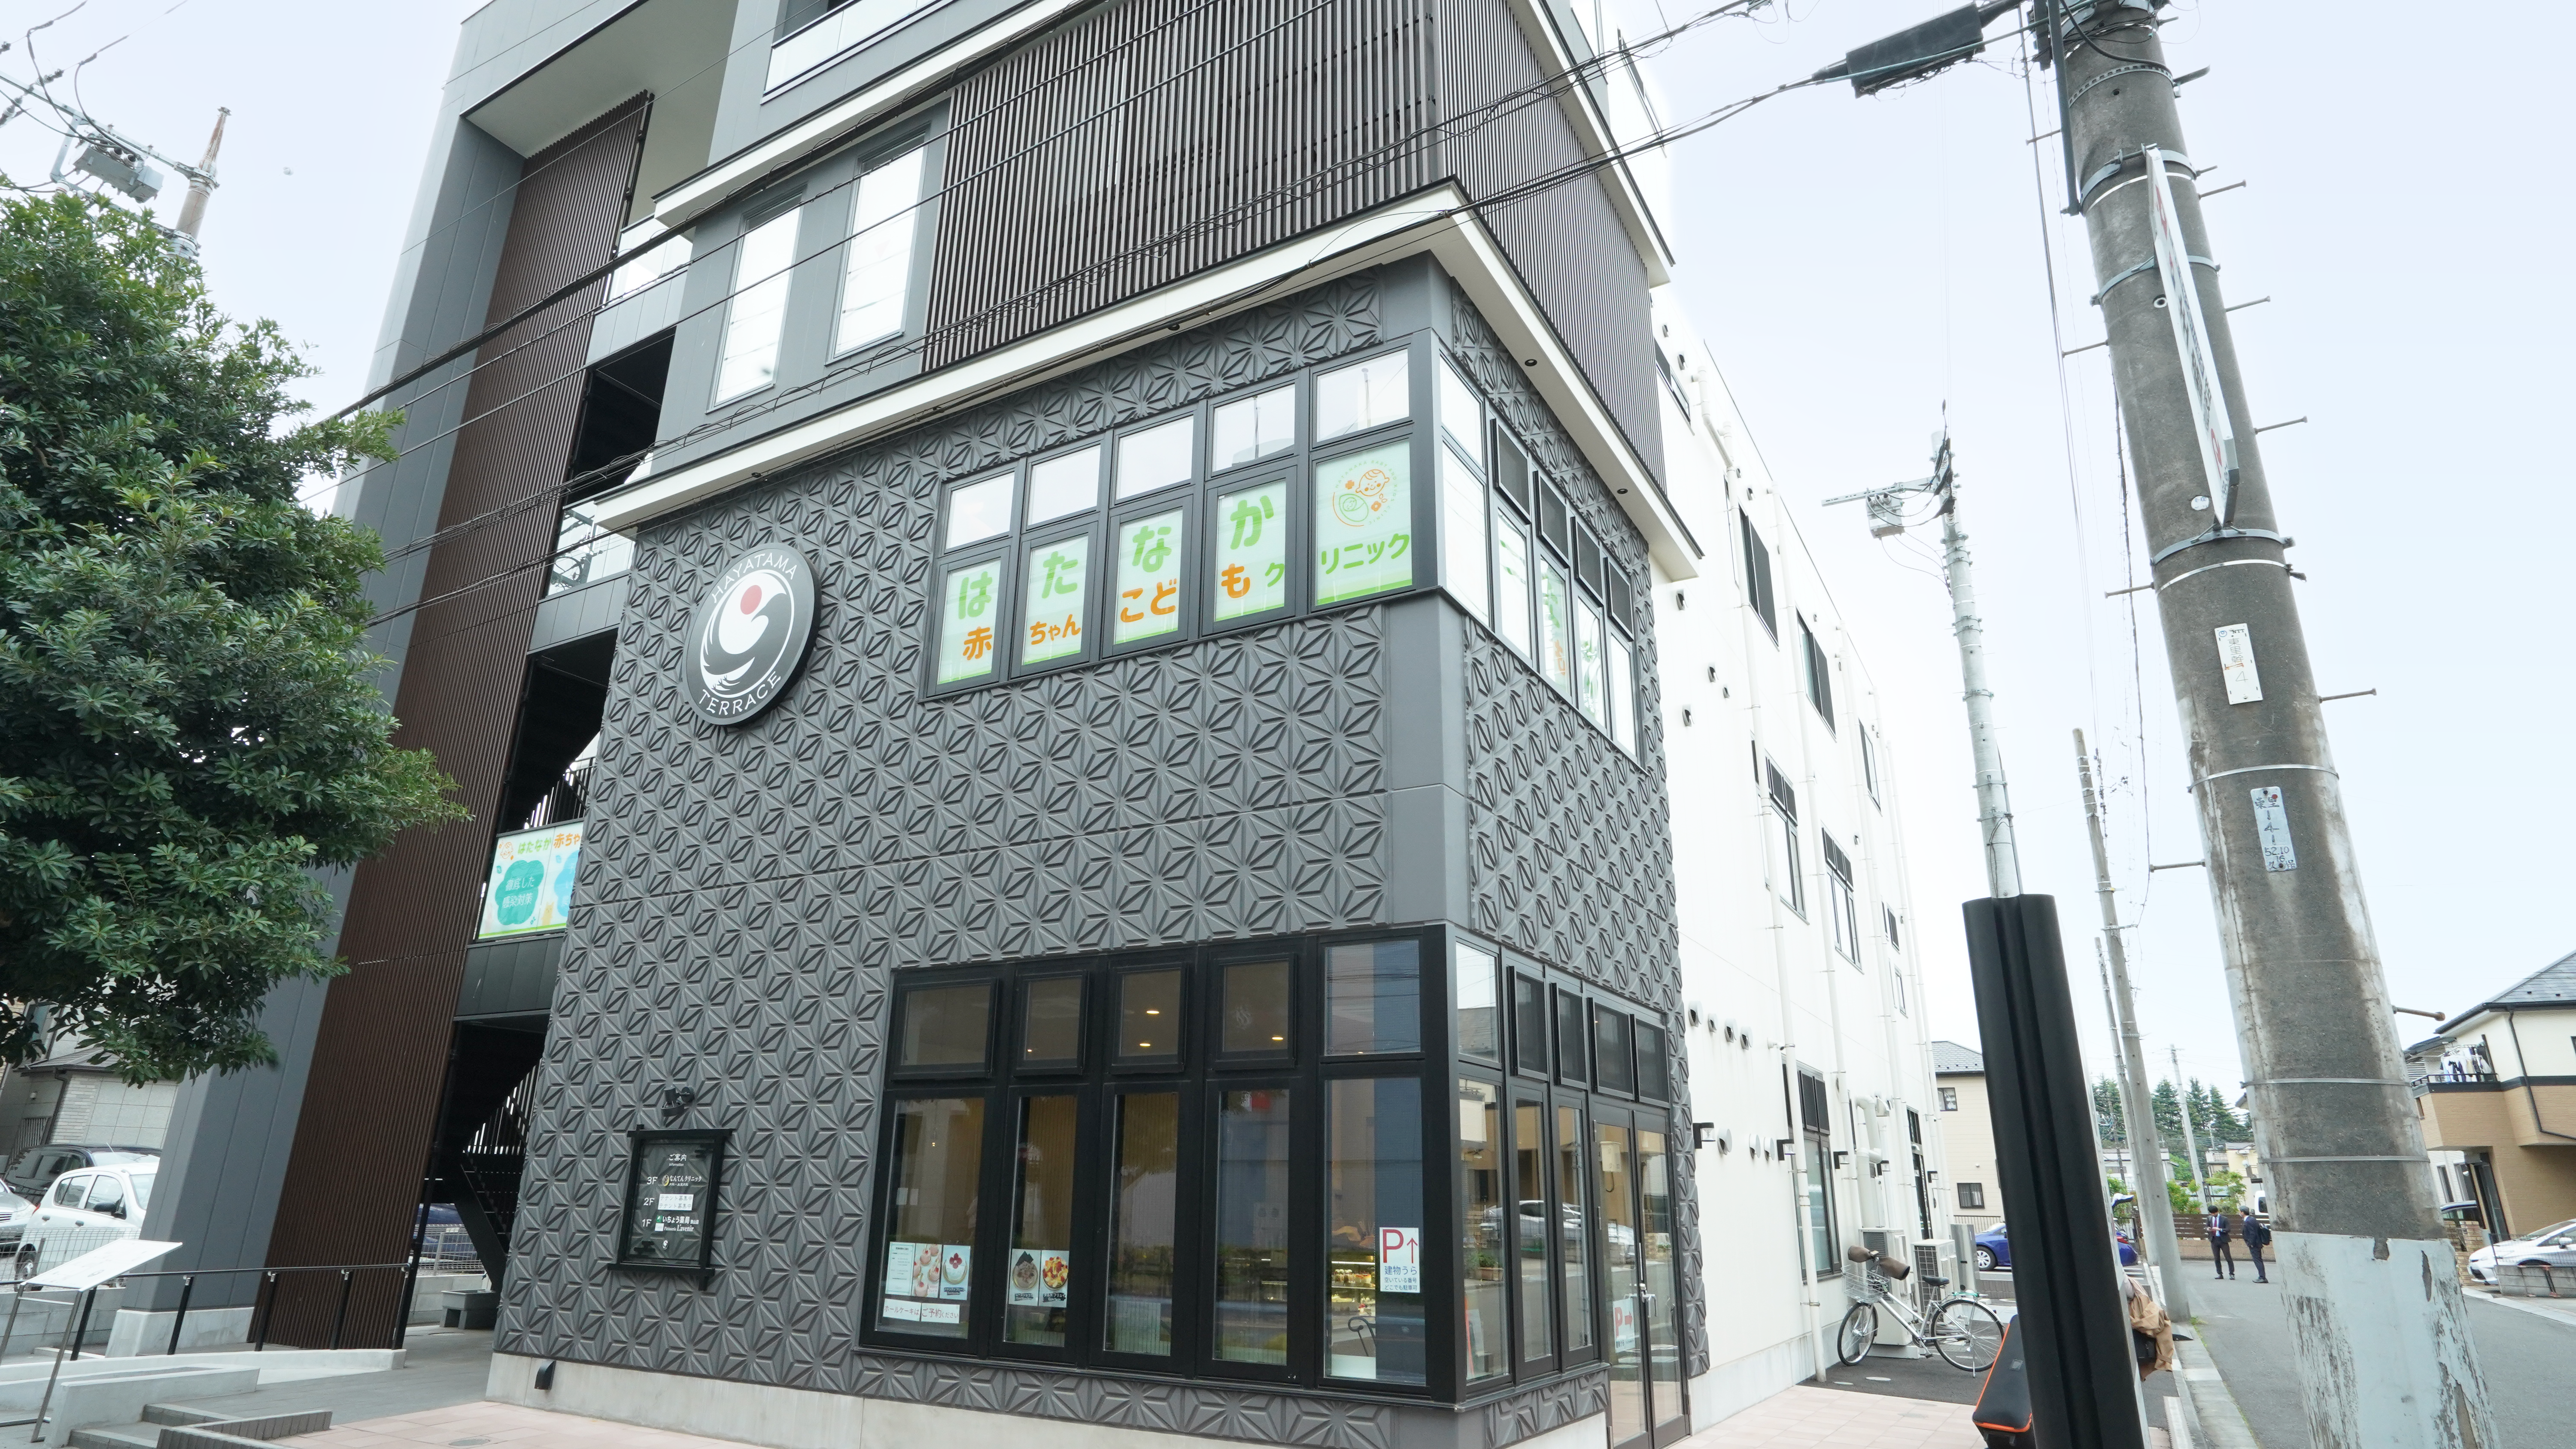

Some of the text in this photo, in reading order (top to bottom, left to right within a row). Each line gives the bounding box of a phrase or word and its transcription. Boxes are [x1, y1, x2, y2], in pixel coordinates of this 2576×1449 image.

[711, 552, 798, 603] HAYATAMA
[699, 670, 781, 715] TERRACE
[502, 893, 533, 909] 感染対策
[669, 1153, 687, 1161] ご案内
[647, 1176, 658, 1185] 3F
[643, 1197, 655, 1206] 2F
[642, 1219, 652, 1227] 1F
[662, 1216, 690, 1224] いちょう薬局
[1382, 1229, 1404, 1264] P
[1385, 1265, 1417, 1275] 建物うら
[884, 1306, 919, 1316] ホールケーキは
[922, 1308, 959, 1318] ご予約ください
[1614, 1307, 1623, 1338] P
